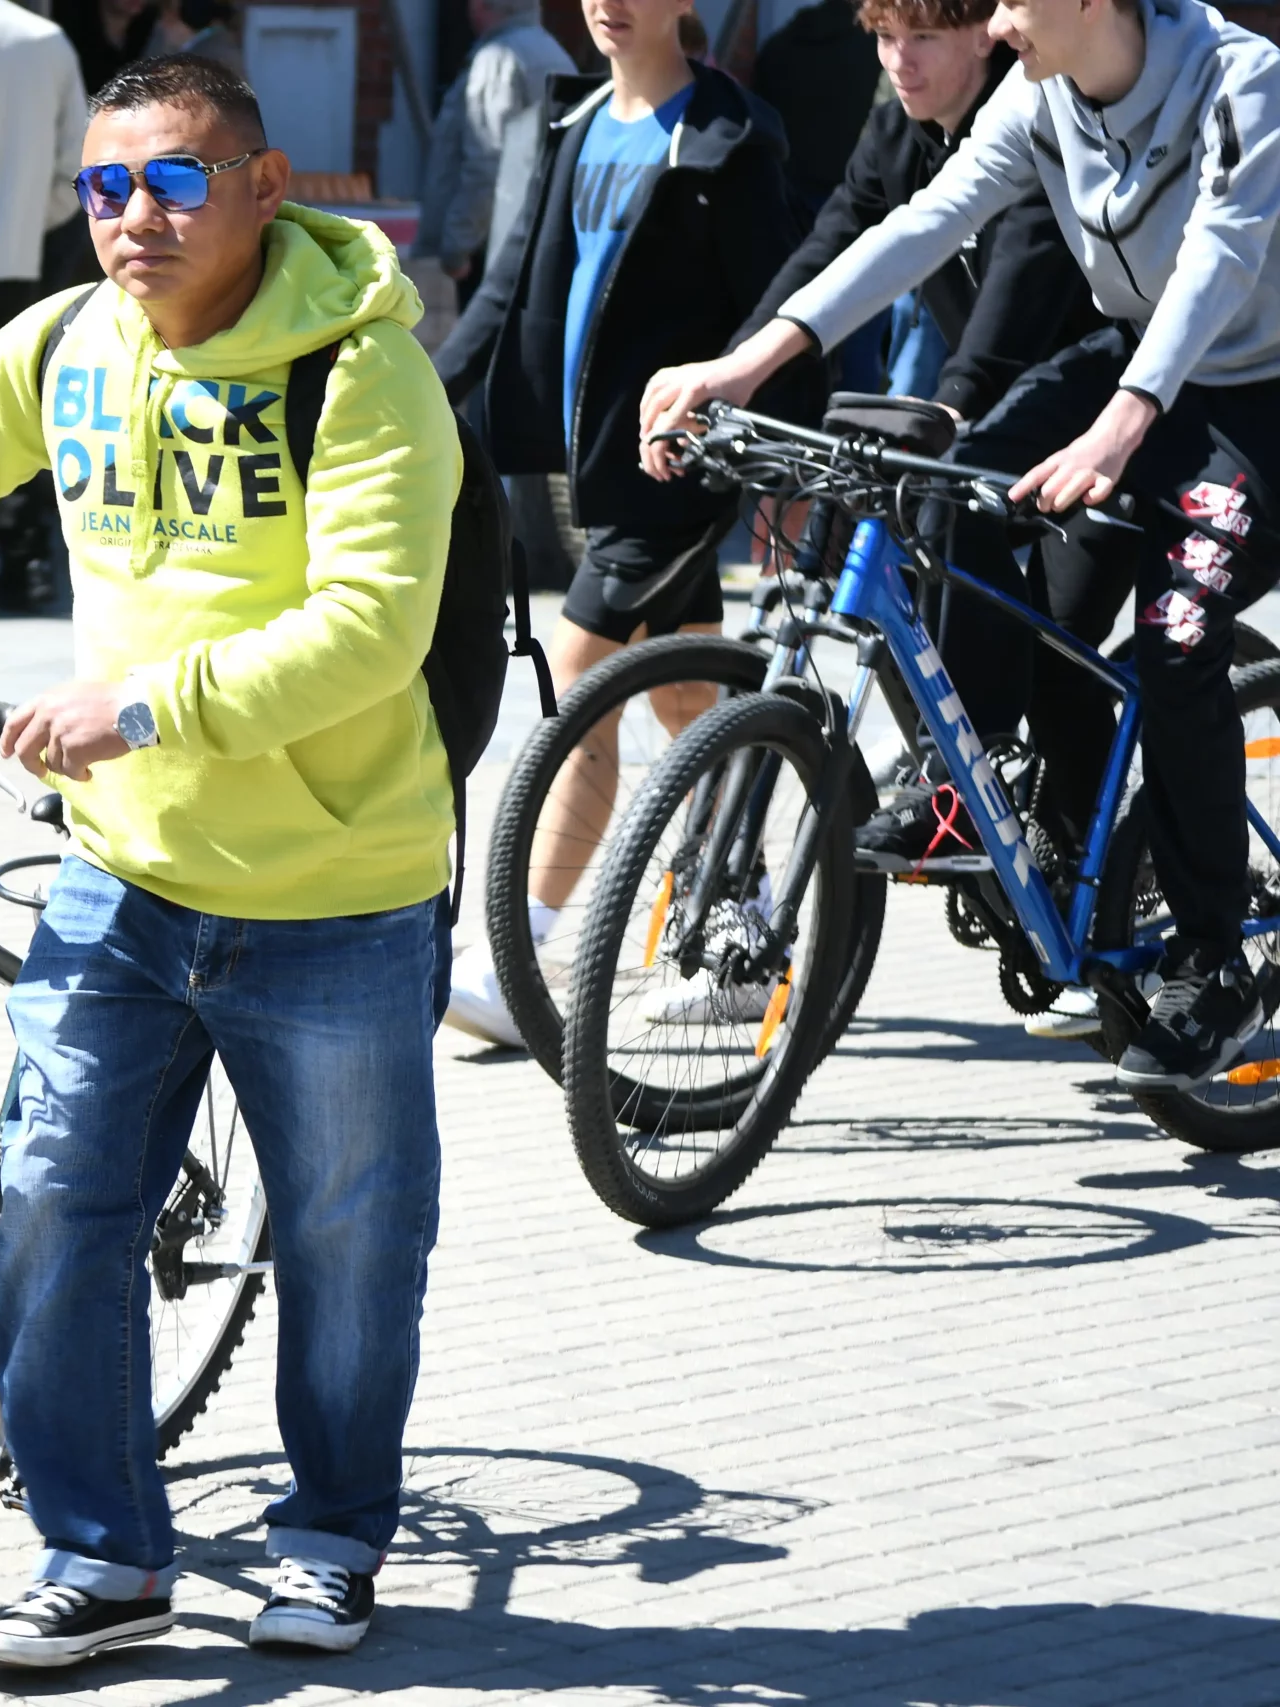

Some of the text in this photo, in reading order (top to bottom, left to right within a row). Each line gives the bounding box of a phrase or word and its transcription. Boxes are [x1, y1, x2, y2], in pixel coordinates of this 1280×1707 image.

[57, 438, 287, 518] OLIVE
[81, 511, 238, 543] JEAN ASCALE
[914, 622, 1041, 889] TREK
